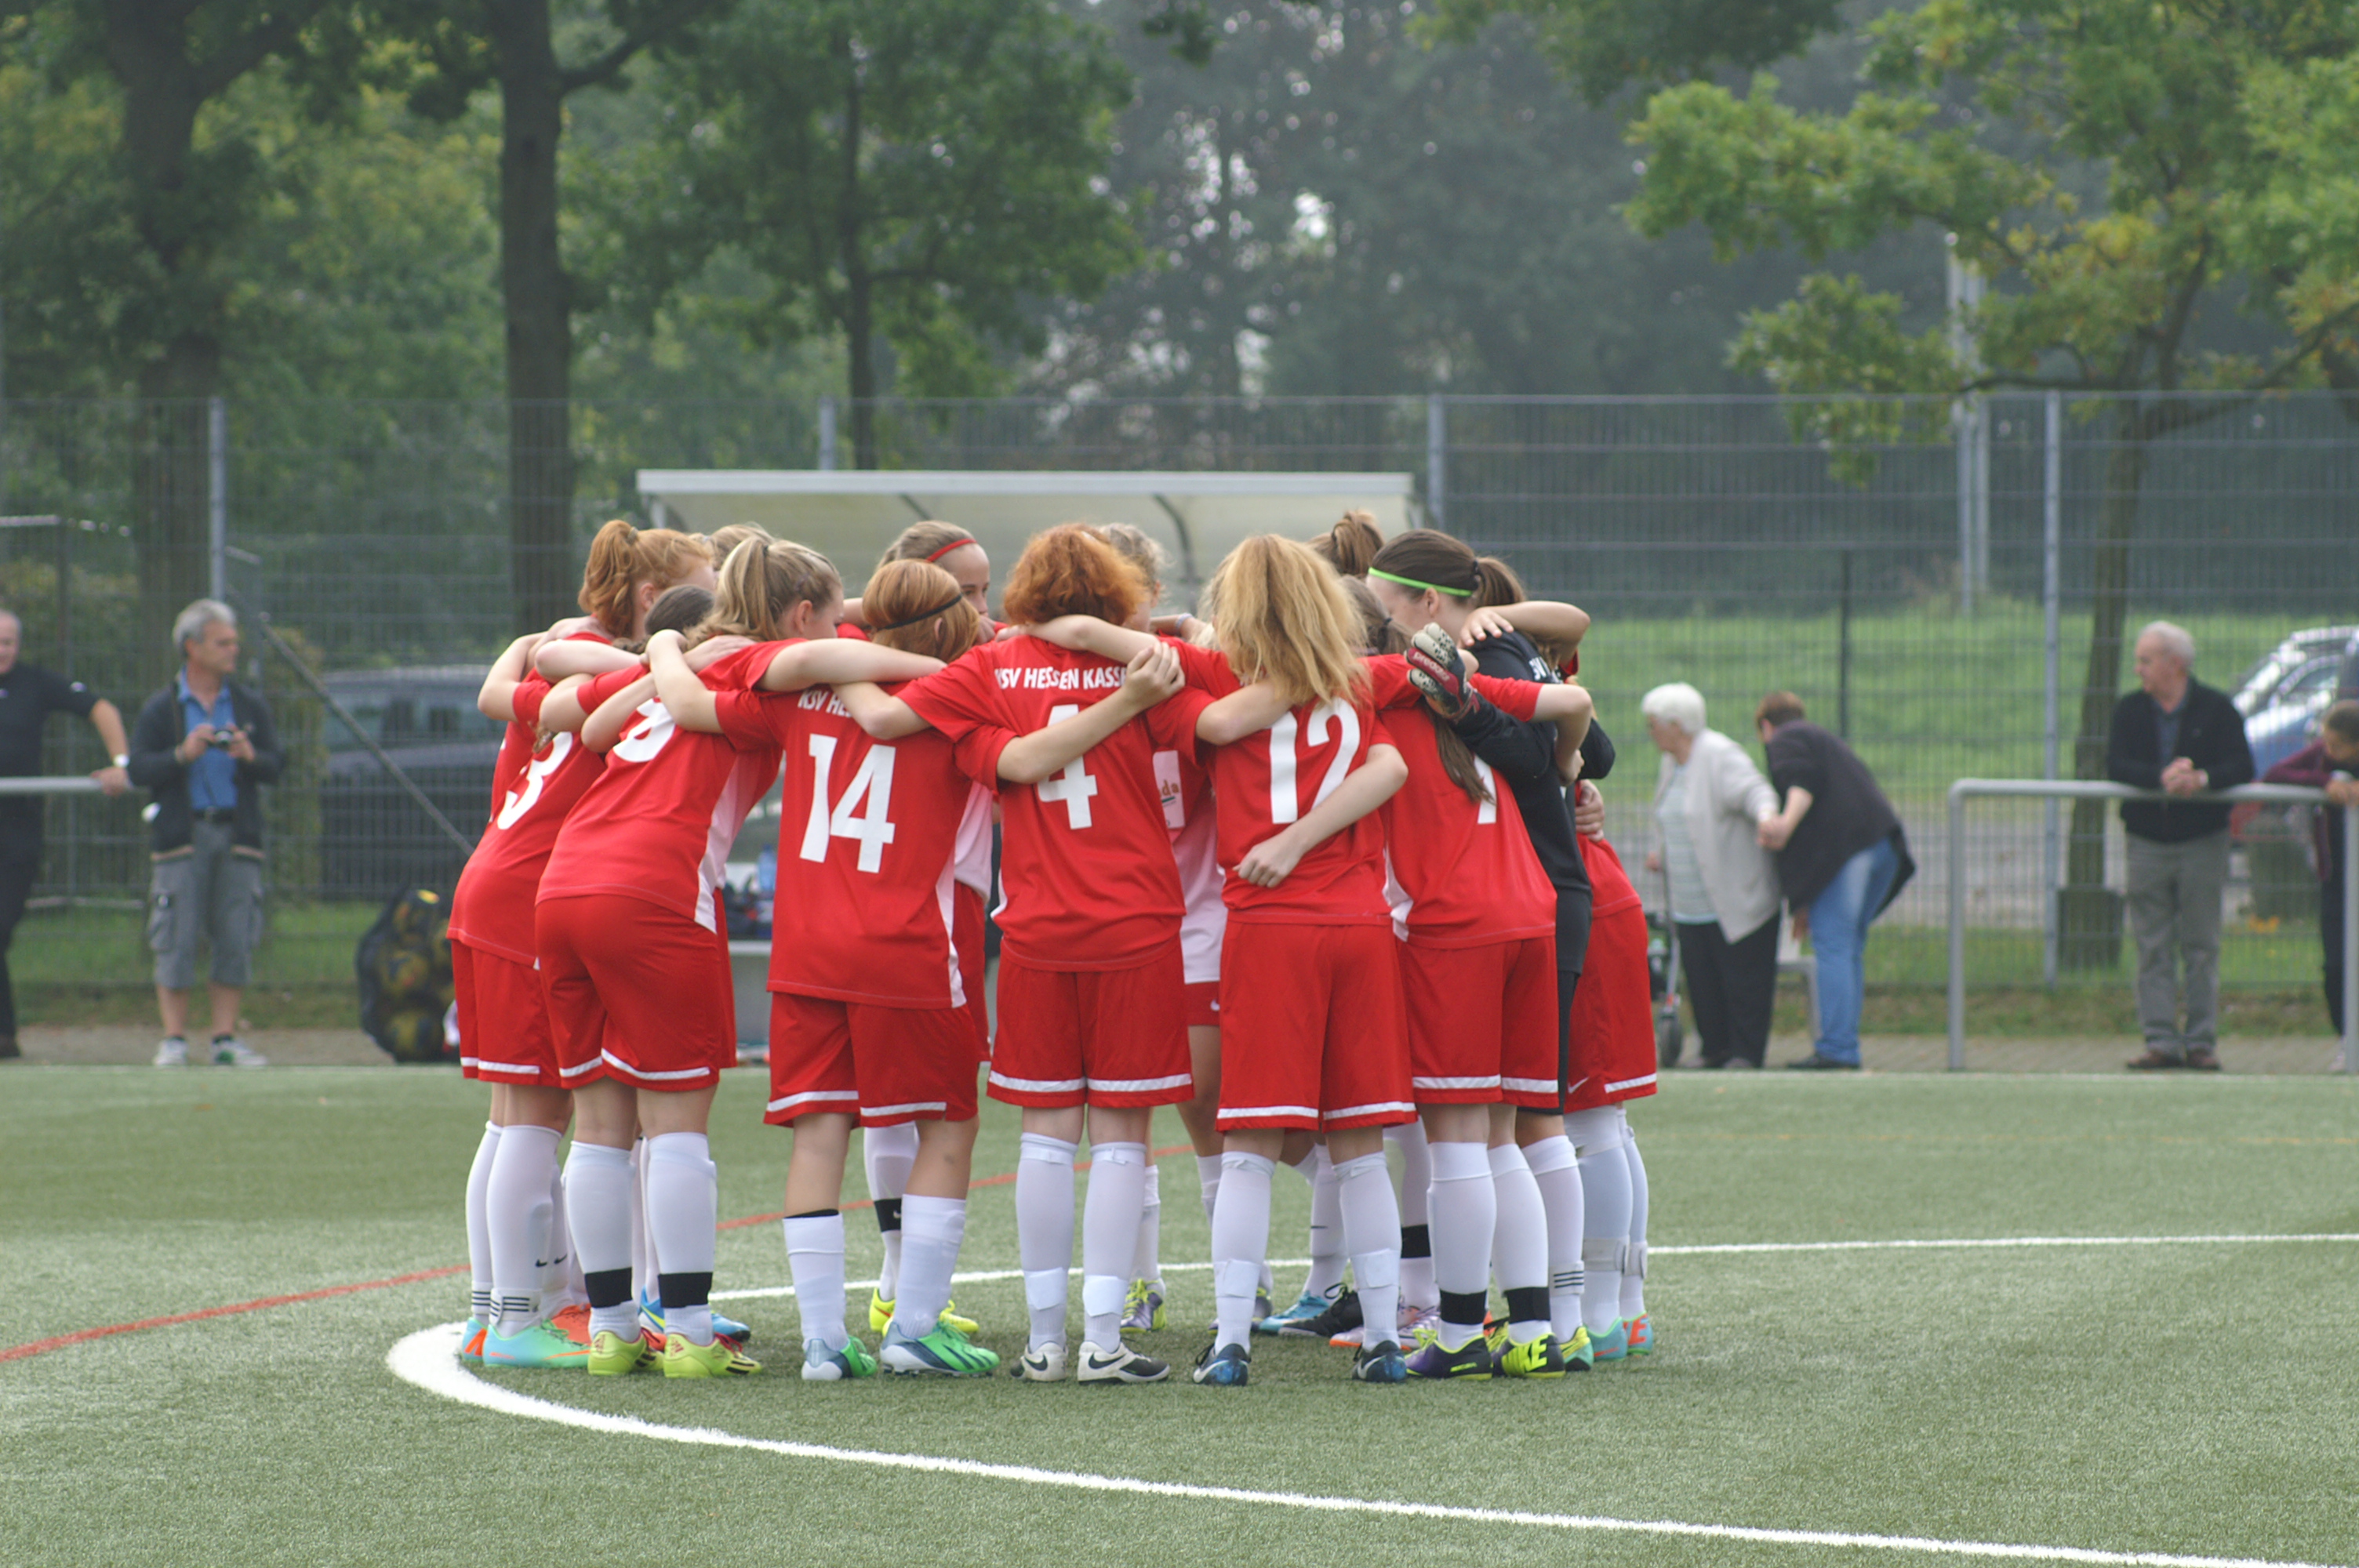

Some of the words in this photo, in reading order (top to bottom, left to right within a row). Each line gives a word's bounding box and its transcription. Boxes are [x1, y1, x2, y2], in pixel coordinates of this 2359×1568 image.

[1023, 666, 1079, 690] HESSEN
[799, 733, 896, 873] 14
[1036, 703, 1098, 829] 4
[1270, 697, 1361, 824] 12
